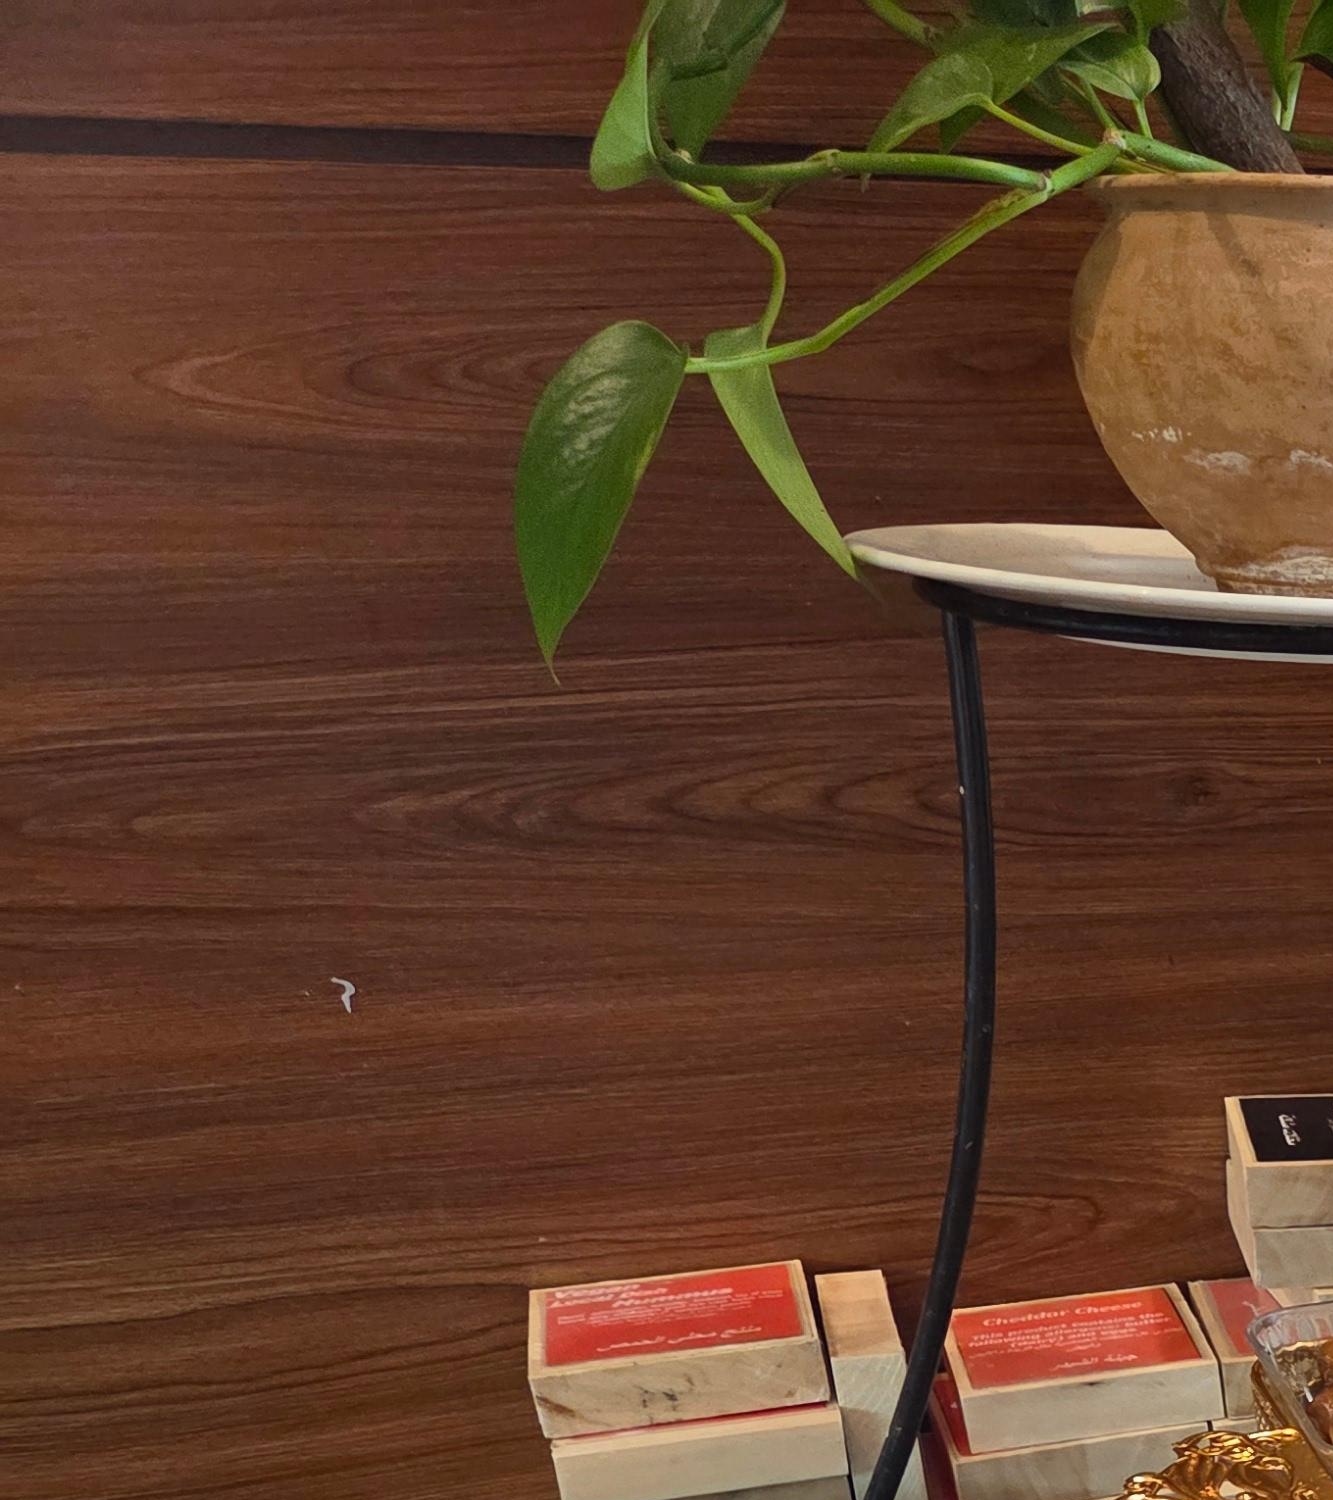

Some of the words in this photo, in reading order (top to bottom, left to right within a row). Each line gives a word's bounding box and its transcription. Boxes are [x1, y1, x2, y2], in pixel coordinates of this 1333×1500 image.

[982, 1308, 1072, 1327] Cheddar
[1075, 1300, 1144, 1316] Cheese
[1007, 1323, 1067, 1338] product
[1071, 1315, 1136, 1329] contains
[1139, 1311, 1164, 1320] the
[968, 1334, 1042, 1348] following
